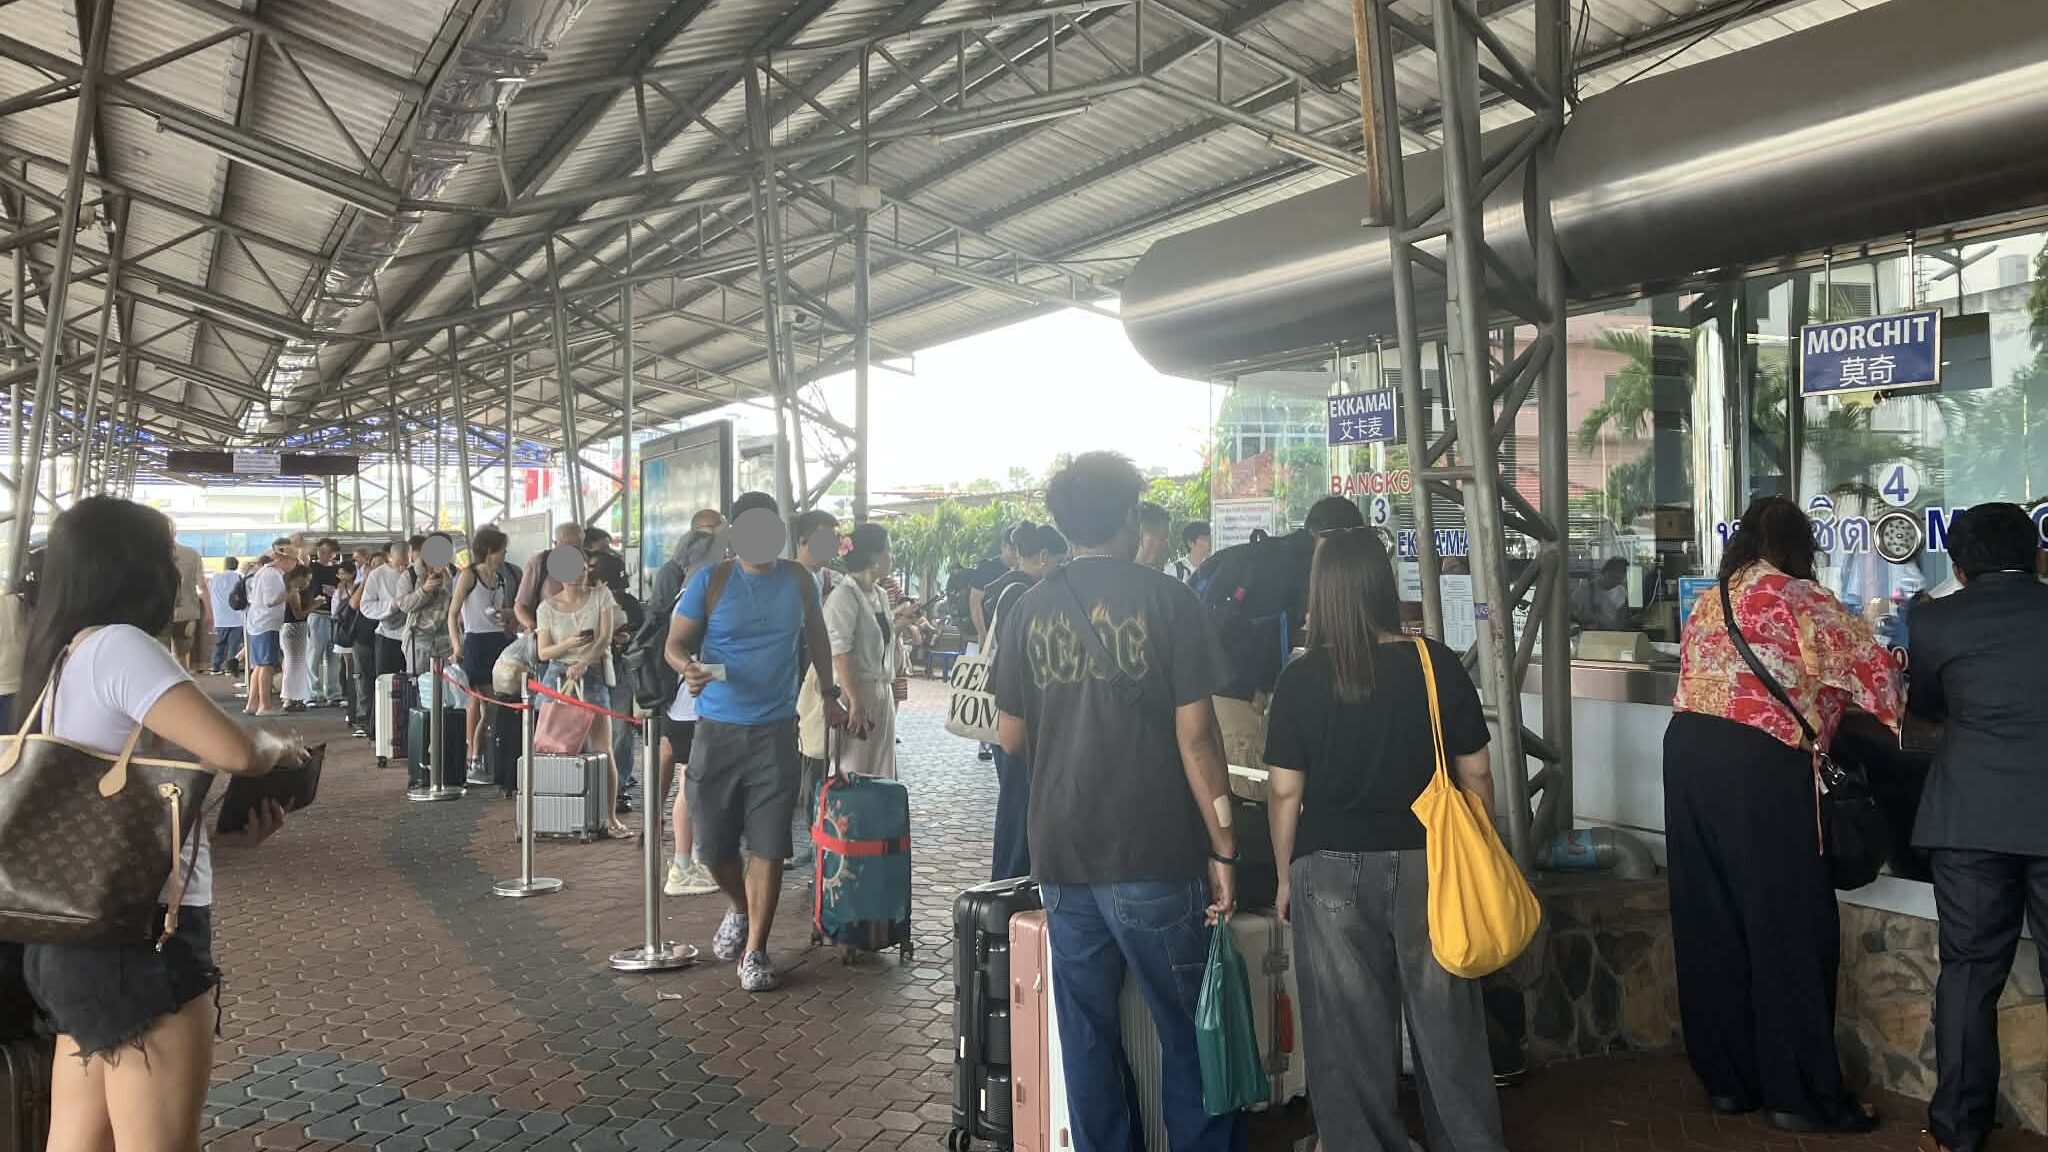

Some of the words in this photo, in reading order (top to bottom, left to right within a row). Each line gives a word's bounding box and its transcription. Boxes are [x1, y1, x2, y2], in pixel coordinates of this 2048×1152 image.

[1808, 316, 1930, 355] MORCHIT
[1839, 353, 1897, 388] 莫奇
[1329, 391, 1391, 418] EKKAMAI
[1338, 415, 1384, 440] 艾卡麦
[1331, 470, 1412, 496] BANGKO
[1882, 465, 1910, 502] 4
[1374, 498, 1386, 525] 3
